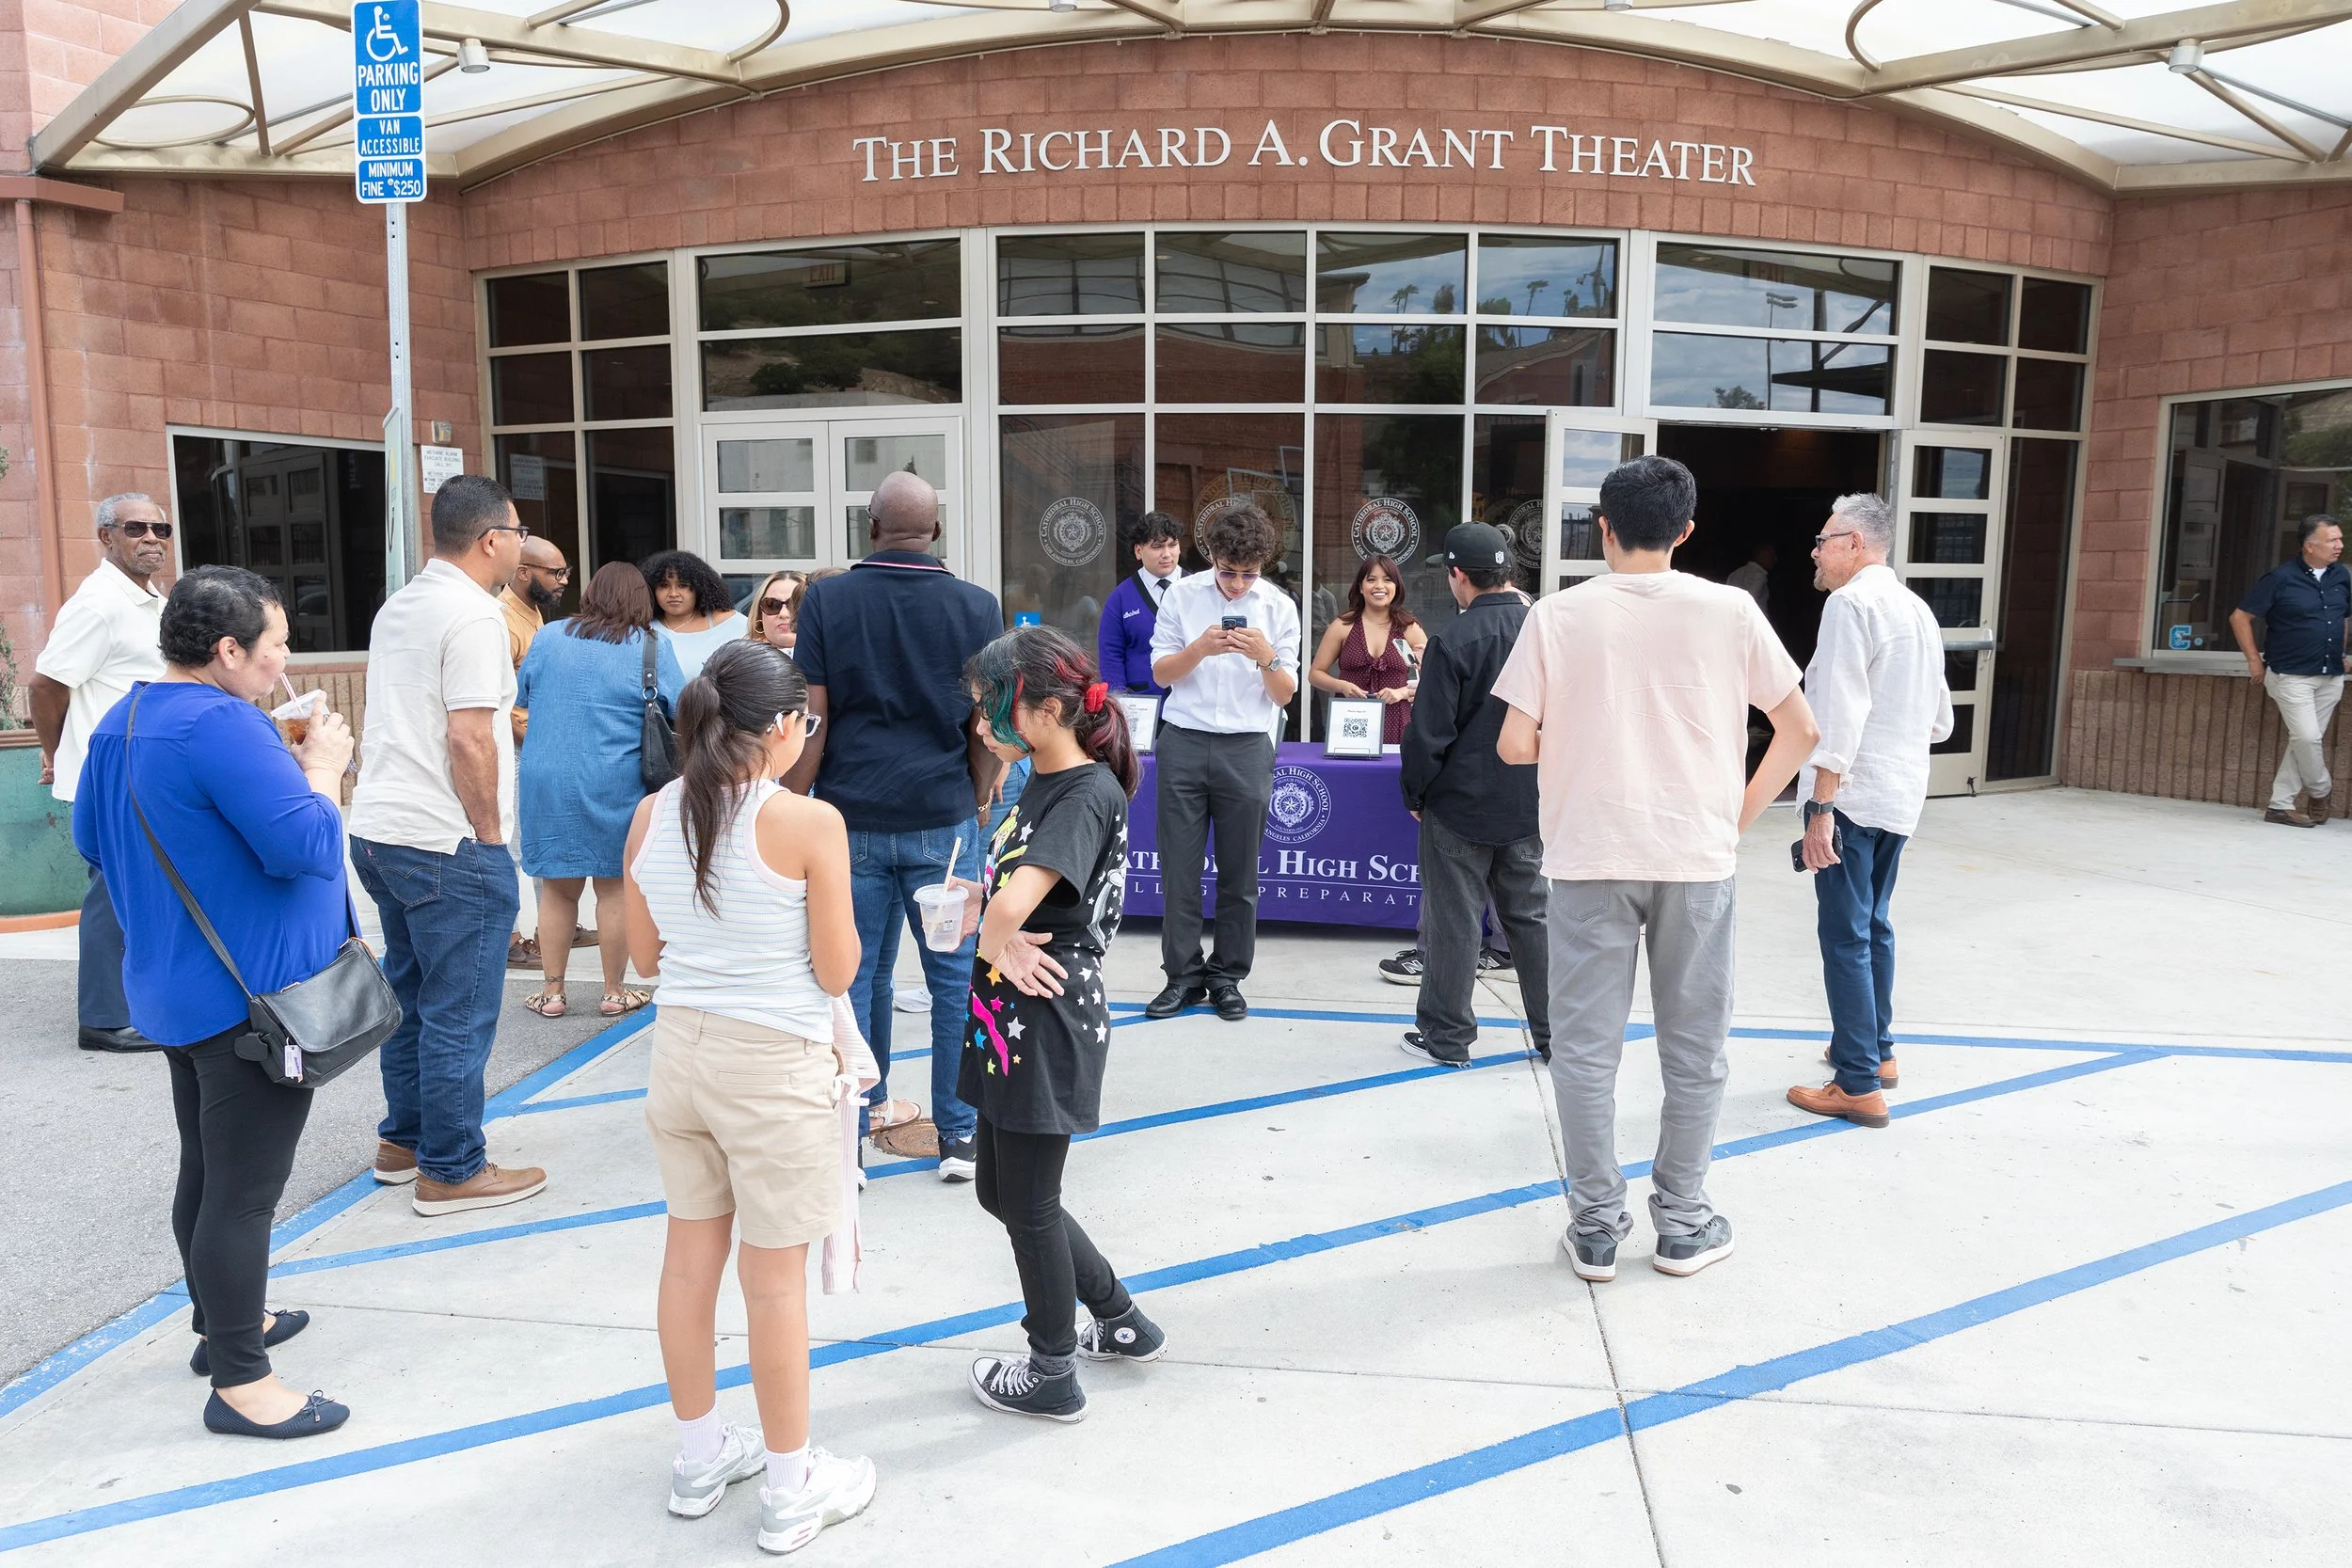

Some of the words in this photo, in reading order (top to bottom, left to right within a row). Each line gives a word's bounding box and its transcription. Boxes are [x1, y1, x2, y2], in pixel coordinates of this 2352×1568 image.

[358, 62, 419, 87] PARKING
[371, 88, 406, 112] ONLY
[379, 119, 400, 135] VAN
[360, 137, 420, 155] ACCESSIBLE
[852, 135, 960, 182] THE
[978, 127, 1232, 175] RICHARD
[1248, 119, 1309, 166] A.
[1318, 119, 1514, 170] GRANT
[1530, 125, 1756, 186] THEATER
[368, 162, 414, 178] MINIMUM
[361, 182, 385, 197] FINE
[393, 180, 421, 198] $250
[1041, 500, 1069, 537] CATHEDRAL
[1070, 499, 1090, 510] HIGH
[1089, 507, 1104, 537] SCHOOL
[1196, 499, 1225, 538] CATHEDRAL
[1353, 500, 1383, 538] CATHEDRAL
[1383, 499, 1405, 511] HIGH
[1402, 508, 1418, 538] SCHOOL
[1510, 502, 1535, 529] THEDRAL
[1075, 543, 1103, 564] CALIFORNIA
[1394, 544, 1416, 563] LIFORNIA
[1289, 768, 1313, 781] HIGH
[1311, 778, 1329, 812] SCHOOL
[1264, 828, 1291, 841] ANGELES
[1293, 819, 1326, 842] CALIFORNIA
[1276, 849, 1359, 879] HIGH
[1257, 886, 1417, 906] PREPARAT
[1587, 1237, 1610, 1245] Reebok
